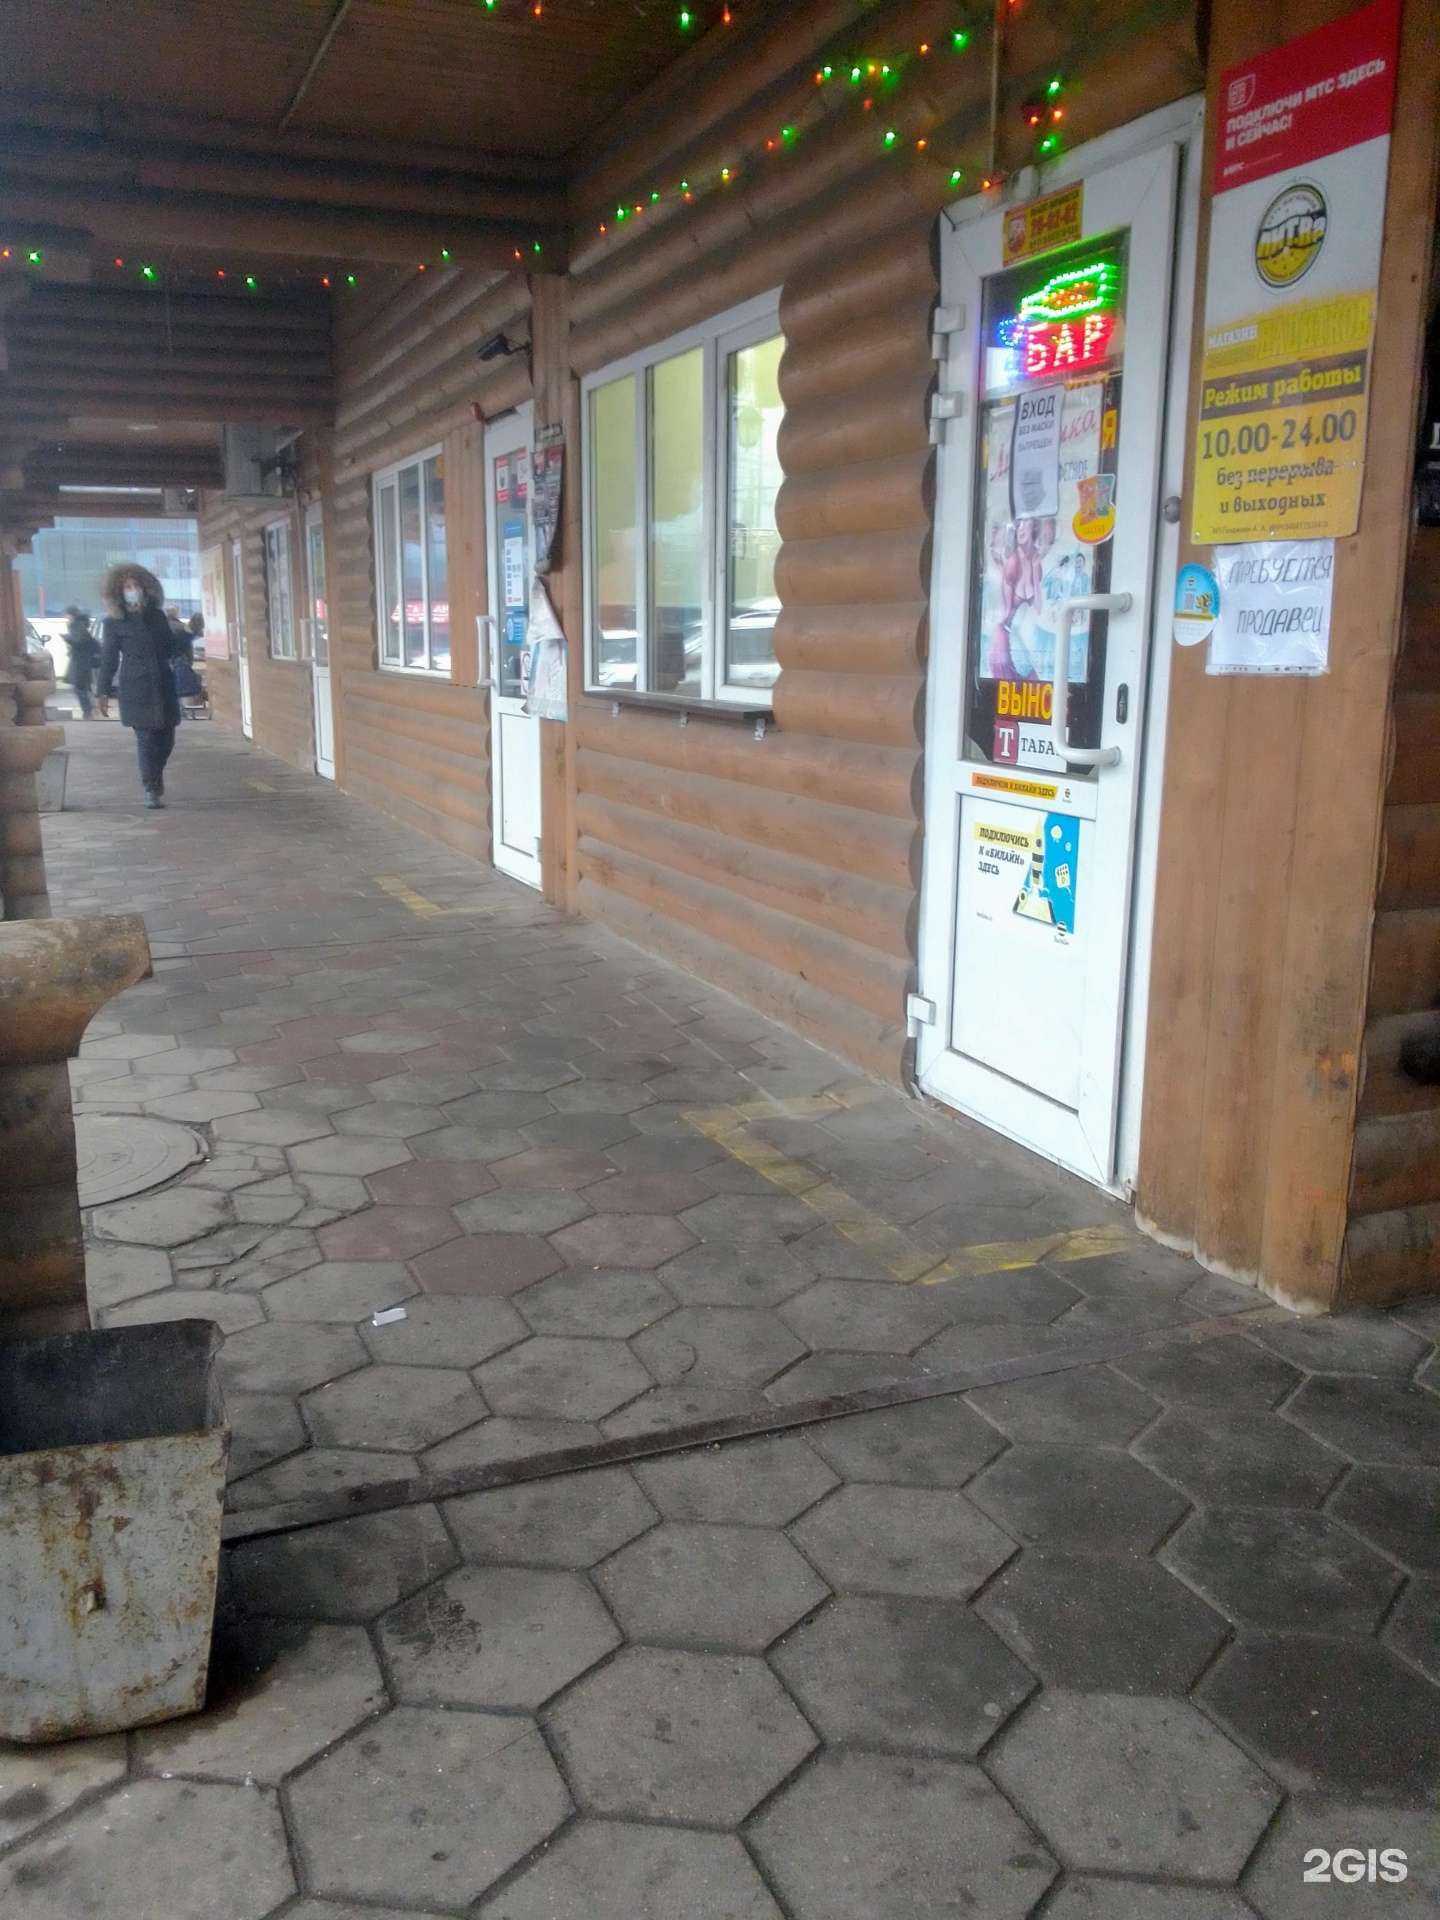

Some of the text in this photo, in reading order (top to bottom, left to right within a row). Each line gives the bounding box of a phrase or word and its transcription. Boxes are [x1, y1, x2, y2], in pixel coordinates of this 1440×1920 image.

[1226, 90, 1303, 133] ПОДКЛЮЧИ
[1304, 78, 1336, 102] МТС
[1337, 58, 1386, 89] ЗДЕСЬ
[1027, 314, 1104, 373] БАР
[1204, 364, 1362, 409] Режим работы
[1020, 395, 1056, 420] ВХОД
[1202, 409, 1357, 460] 10.00-24.00
[1216, 456, 1335, 490] без перерыва
[1219, 493, 1327, 516] и выходных
[1020, 737, 1056, 757] ТАБА
[978, 845, 985, 855] К
[979, 827, 1030, 848] ПОДКЛЮЧИСЬ
[978, 861, 1000, 875] ЗДЕСЬ
